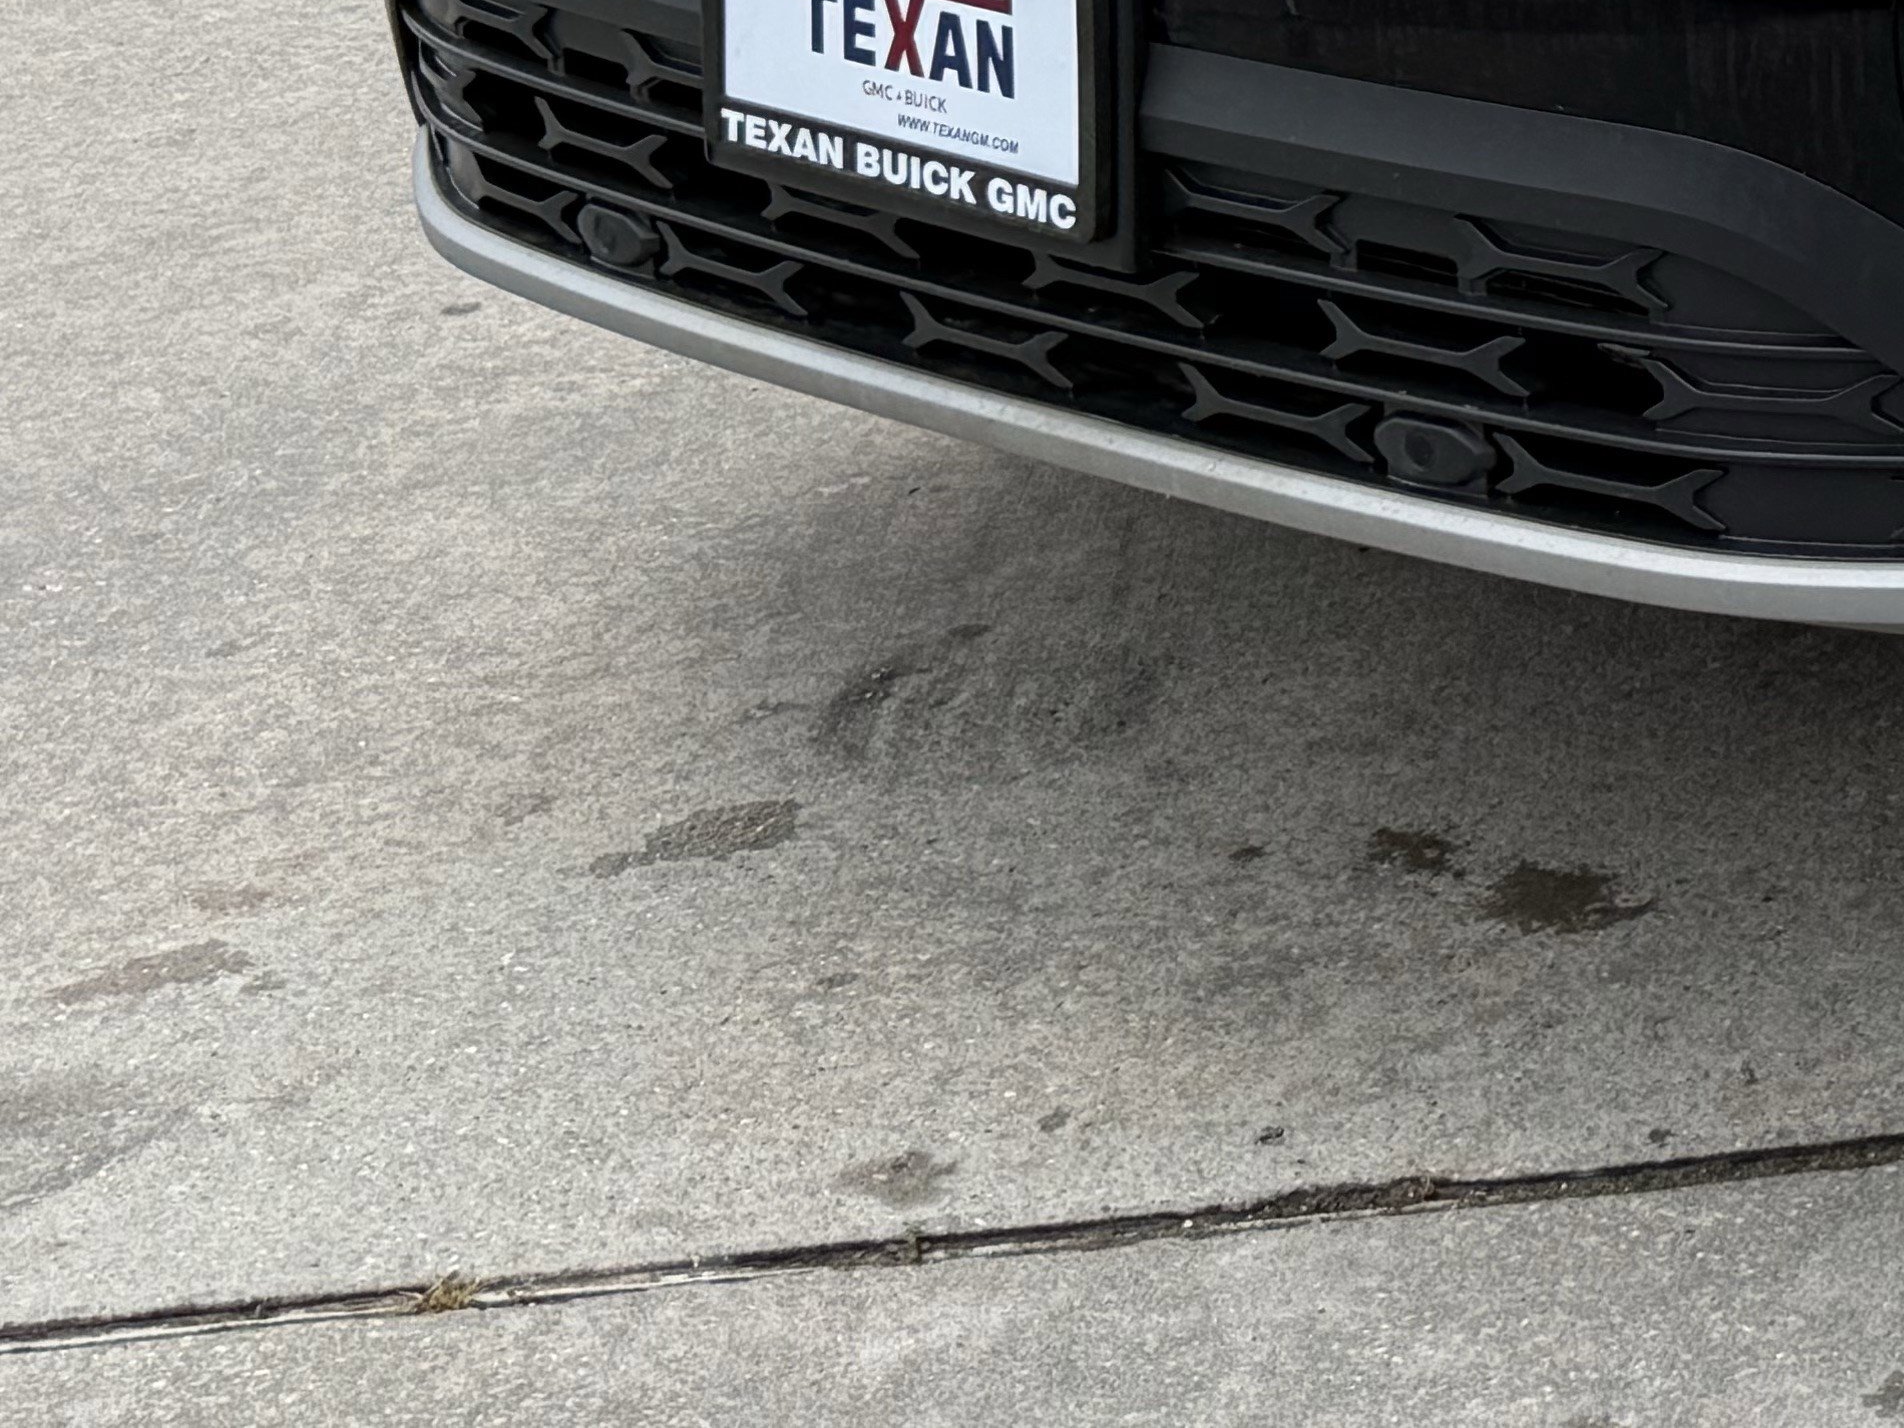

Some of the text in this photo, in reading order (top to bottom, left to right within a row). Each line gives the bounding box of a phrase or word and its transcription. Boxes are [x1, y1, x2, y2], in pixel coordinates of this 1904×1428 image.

[862, 79, 948, 114] GMC BUICK
[721, 107, 1077, 230] TEXAN BUICK GMC
